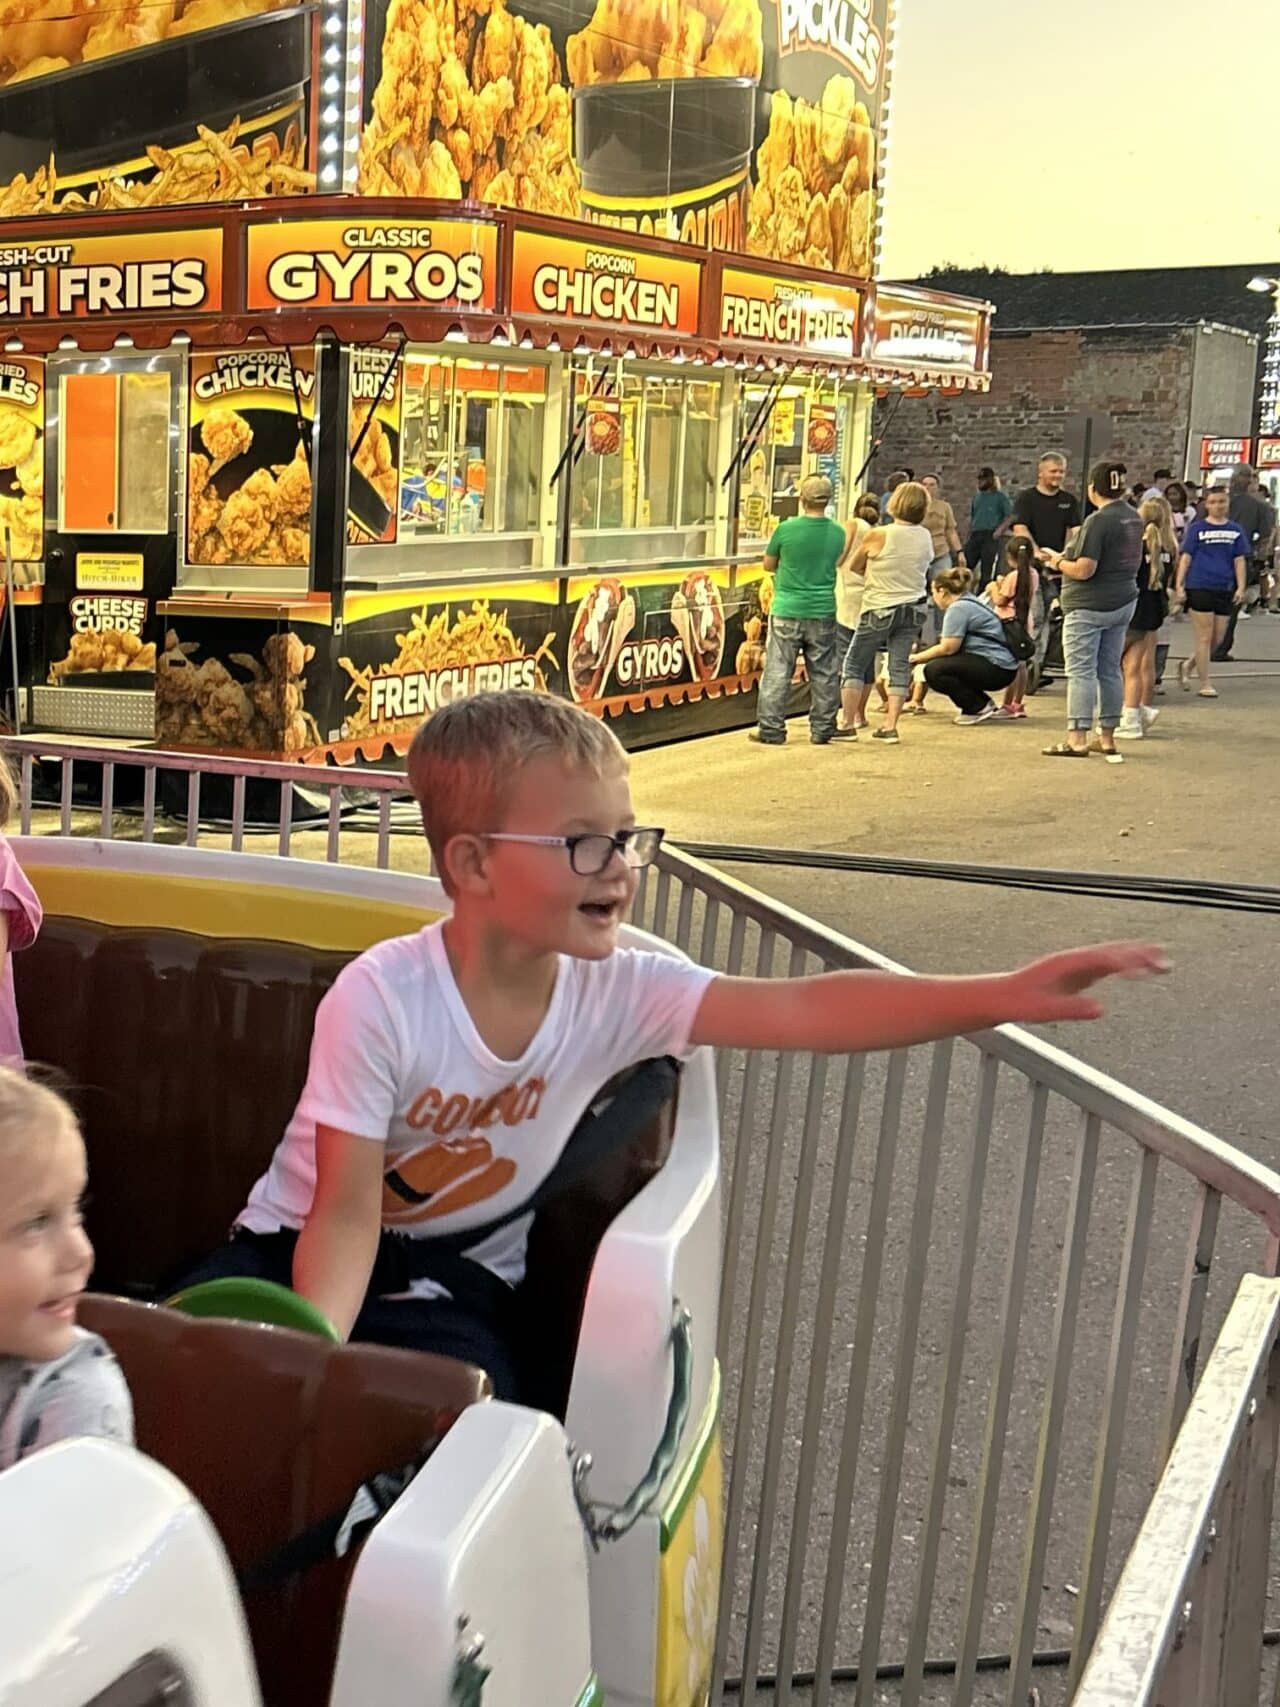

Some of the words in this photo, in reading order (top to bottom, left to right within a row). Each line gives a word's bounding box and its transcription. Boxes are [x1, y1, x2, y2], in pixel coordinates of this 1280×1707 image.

[780, 0, 880, 86] PICKLES
[344, 228, 431, 248] CLASSIC
[269, 253, 483, 301] GYROS
[586, 251, 635, 274] POPCORN
[58, 260, 205, 312] FRIES
[533, 266, 678, 326] CHICKEN
[721, 295, 801, 342] FRENCH
[804, 311, 854, 342] FRIES
[195, 365, 315, 398] CHICKEN
[218, 352, 290, 370] POPCORN
[72, 598, 146, 618] CHEESE
[75, 616, 141, 636] CURDS
[618, 640, 683, 682] GYROS
[370, 667, 470, 721] FRENCH
[474, 658, 535, 693] FRIES
